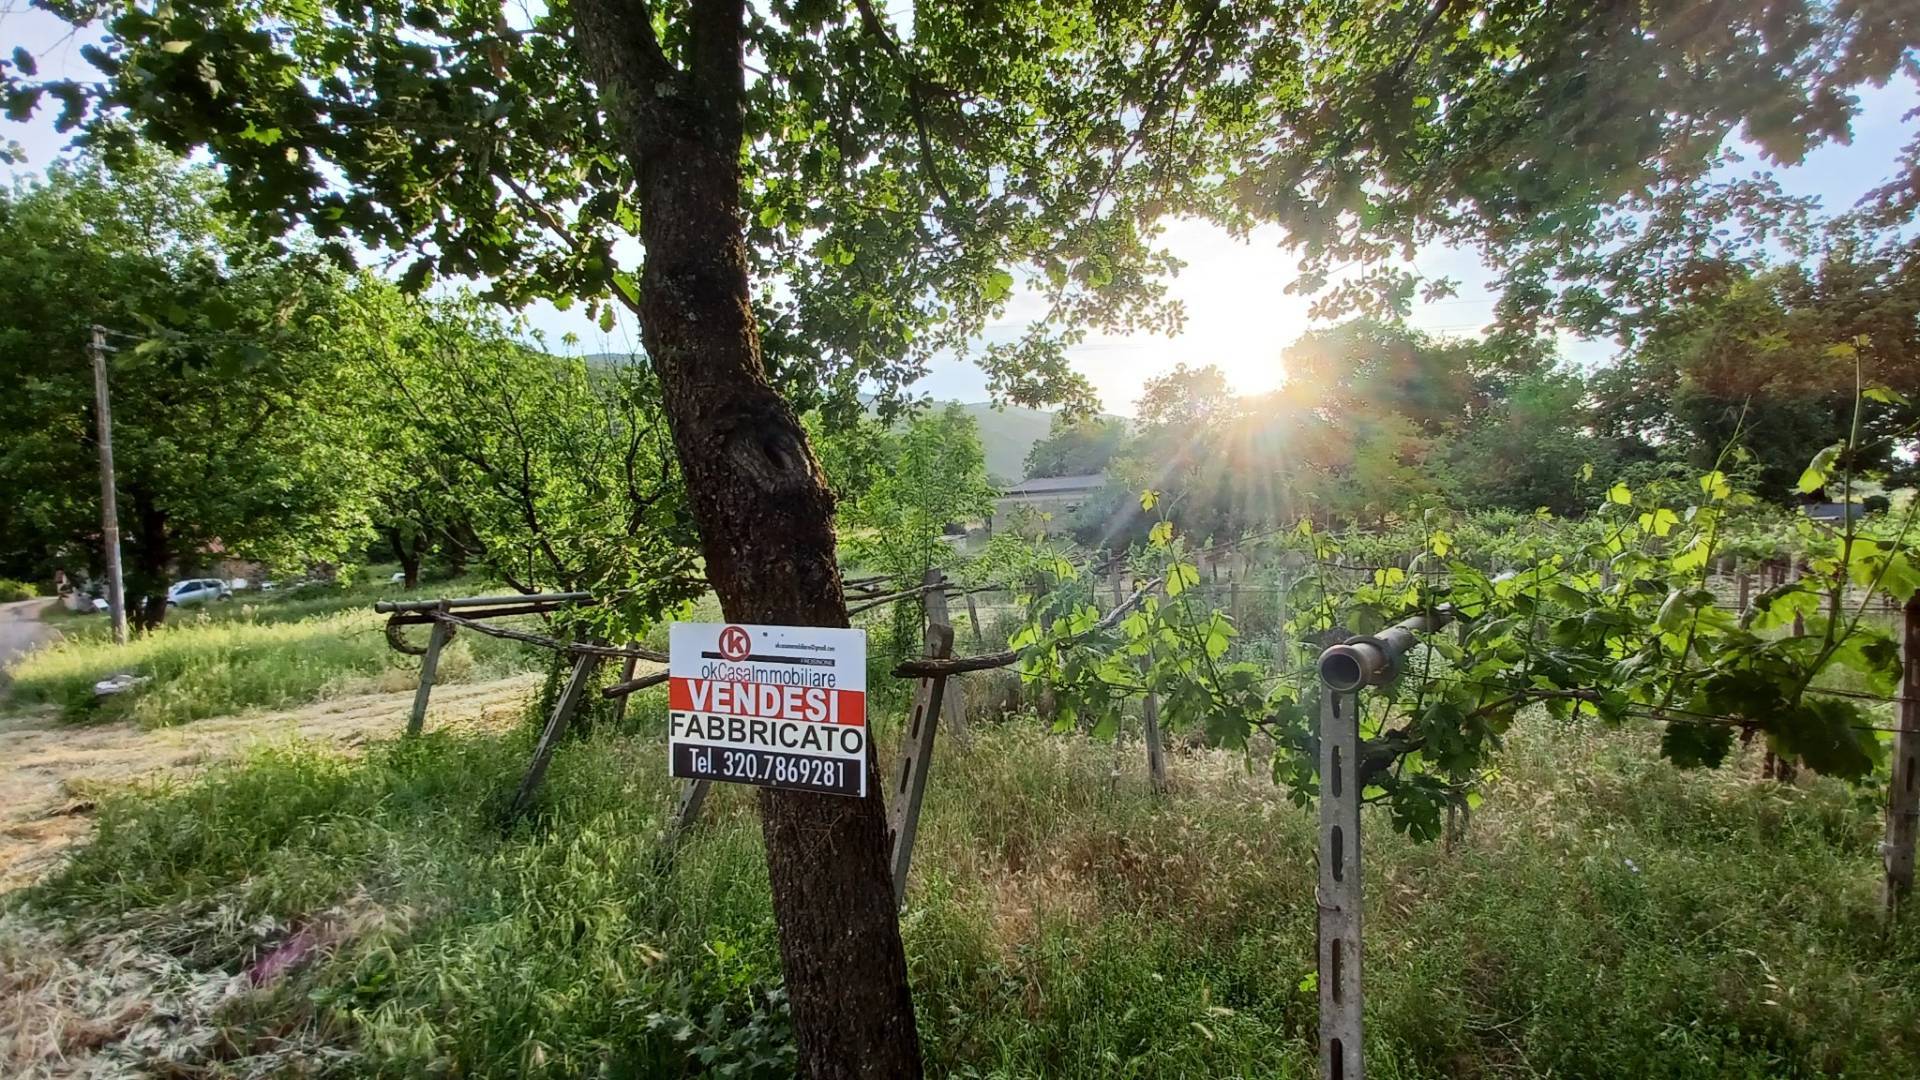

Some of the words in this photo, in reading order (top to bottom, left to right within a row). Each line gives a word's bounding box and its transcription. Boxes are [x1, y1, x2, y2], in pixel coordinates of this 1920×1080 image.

[701, 662, 836, 688] okCasaImmobiliare
[687, 679, 839, 723] VENDESI
[670, 712, 864, 754] FABBRICATO
[689, 747, 717, 774] Tel.
[723, 751, 844, 788] 320.7869281
